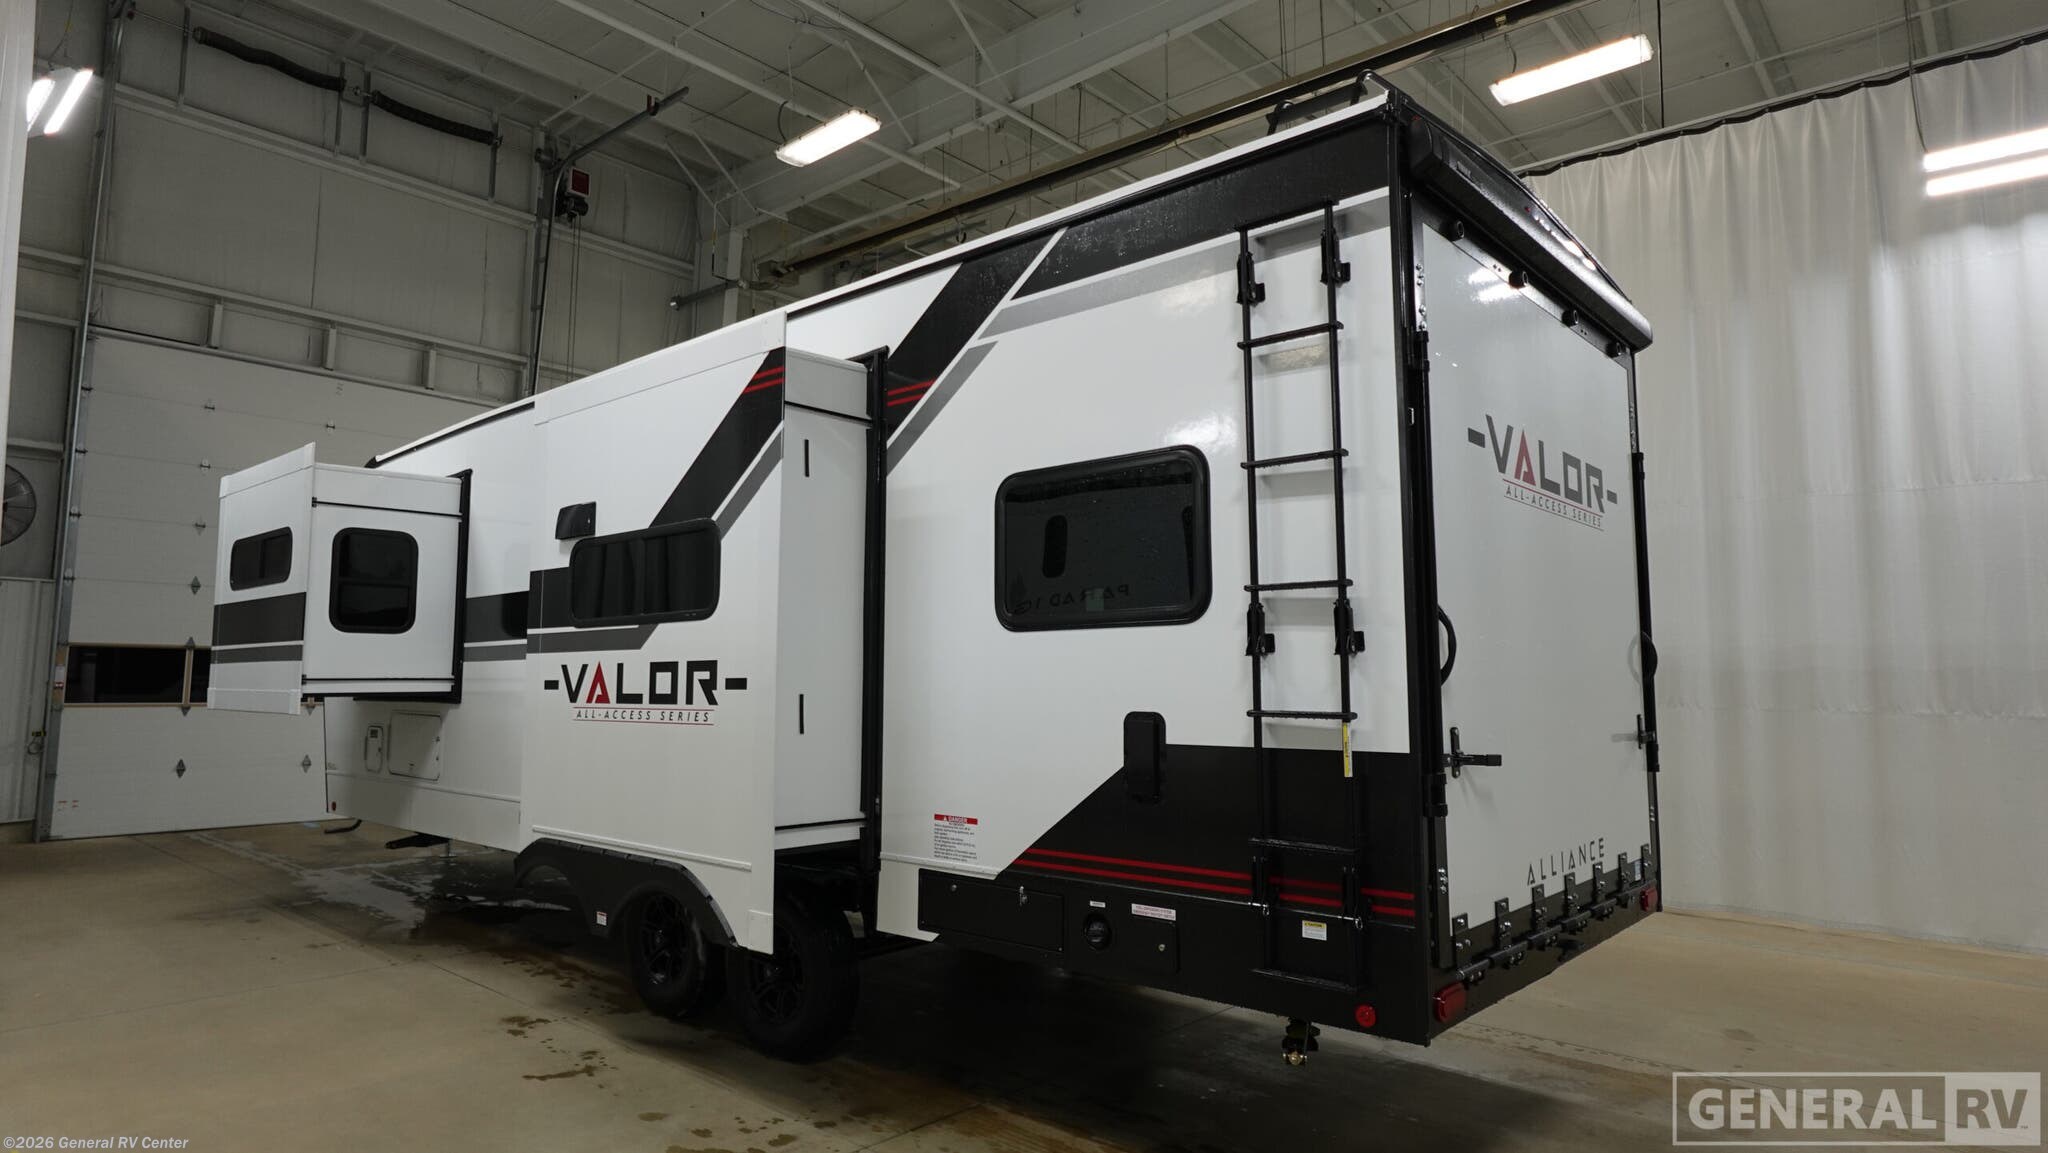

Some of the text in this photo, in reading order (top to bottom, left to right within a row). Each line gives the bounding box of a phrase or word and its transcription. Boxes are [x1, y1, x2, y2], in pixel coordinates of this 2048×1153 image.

[1506, 485, 1601, 527] ALL-ACCESS SERIES
[577, 710, 709, 722] ALL-ACCESS SERIES
[1527, 838, 1604, 886] ALLIANCE
